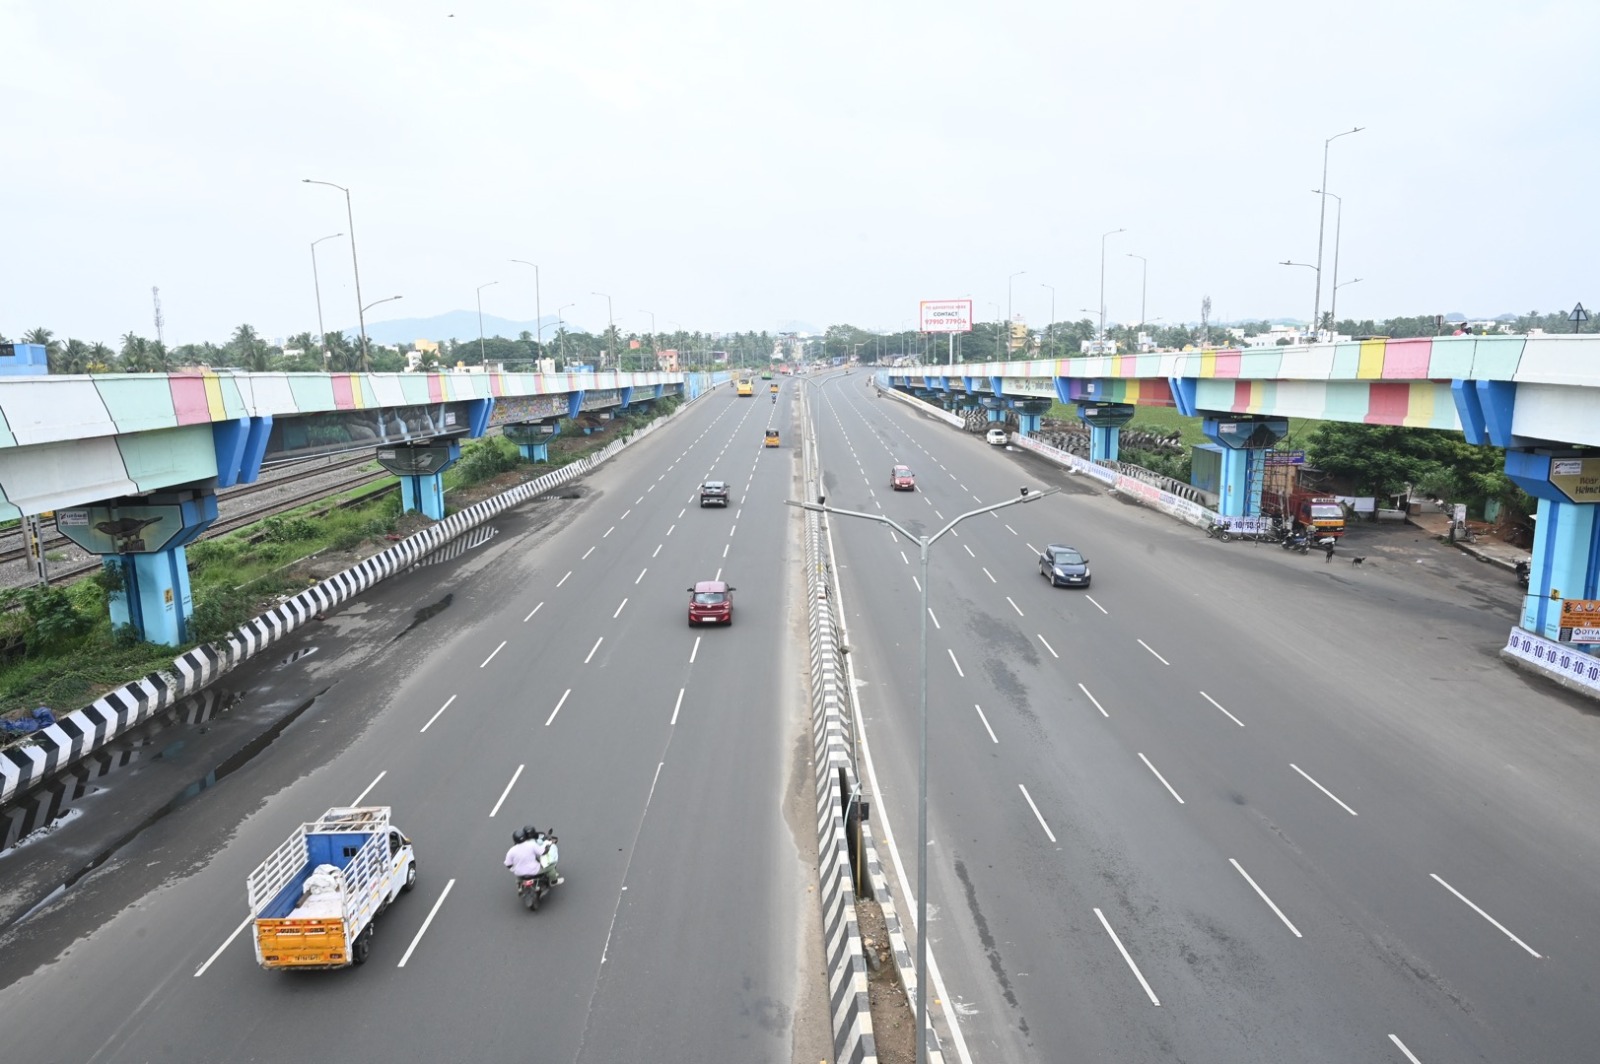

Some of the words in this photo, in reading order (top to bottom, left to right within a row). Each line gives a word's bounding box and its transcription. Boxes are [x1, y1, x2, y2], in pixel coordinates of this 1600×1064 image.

[1510, 635, 1518, 647] 10
[1522, 640, 1530, 652] 10
[1535, 645, 1543, 658] 10
[1547, 650, 1556, 663] 10
[1560, 656, 1569, 668] 10
[1574, 661, 1584, 674] 10
[1588, 666, 1598, 680] 10
